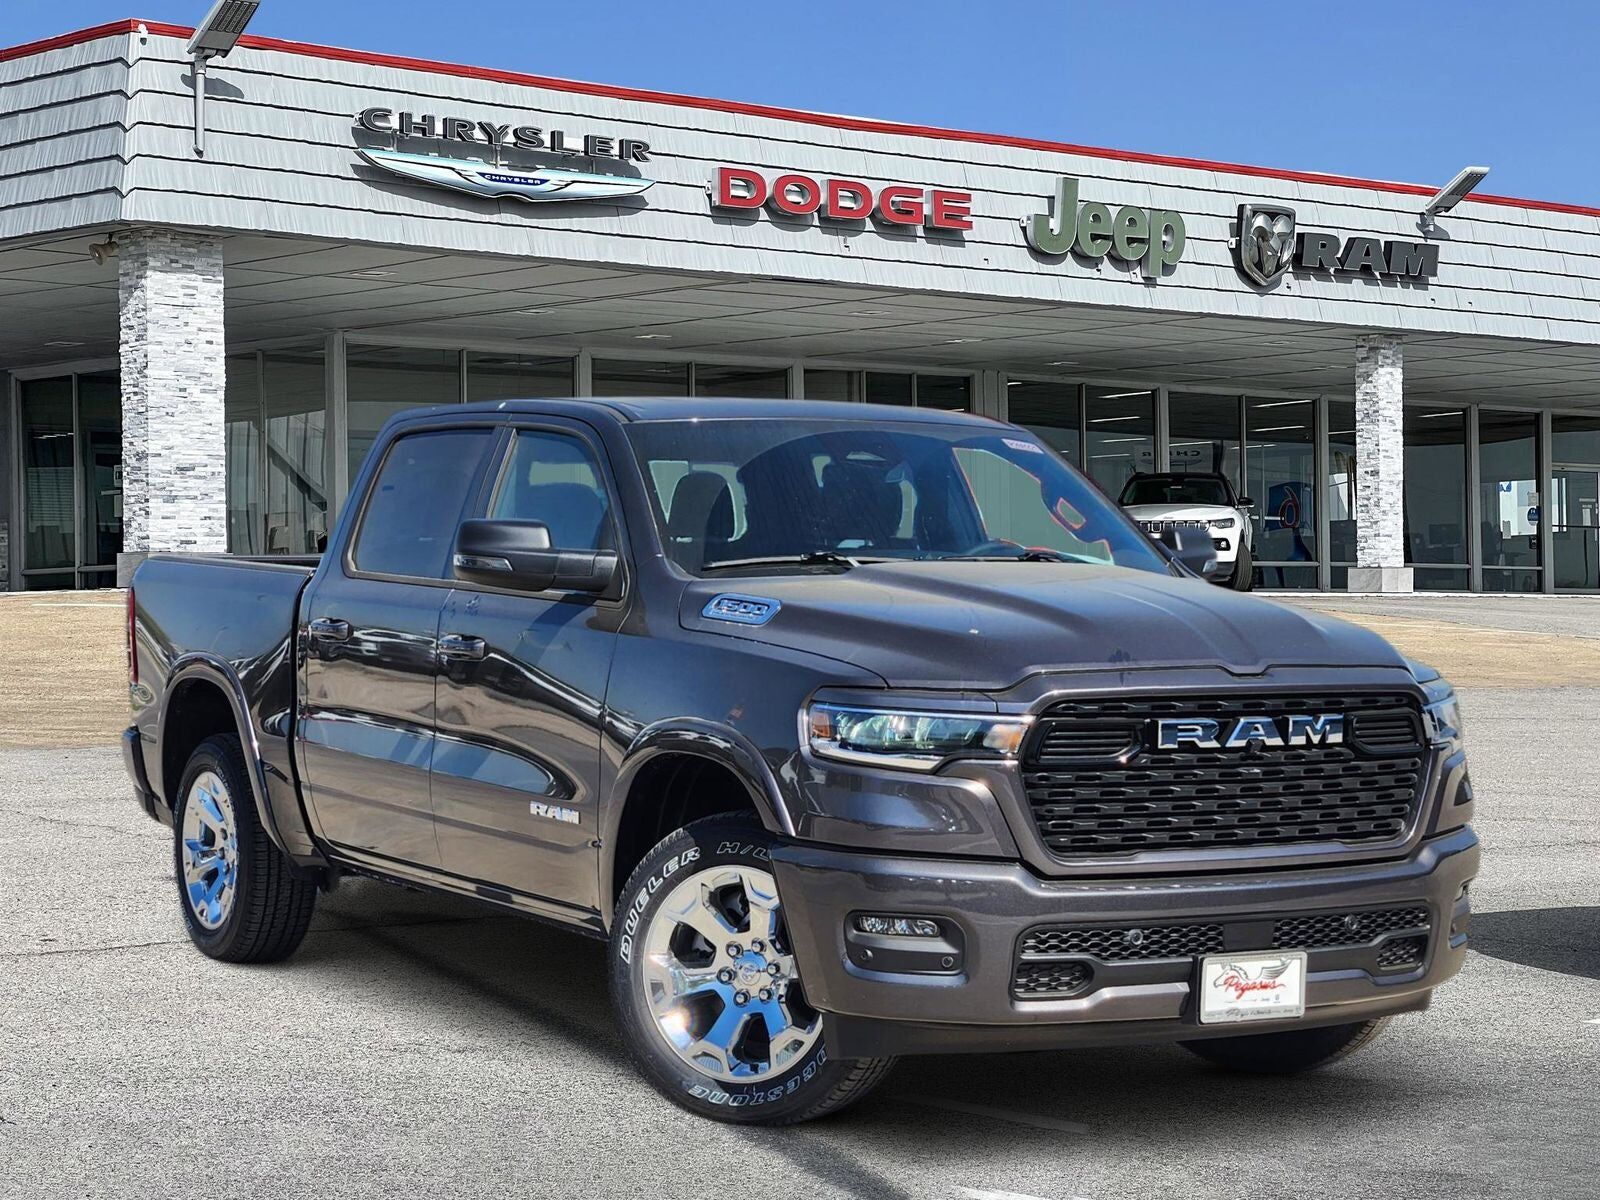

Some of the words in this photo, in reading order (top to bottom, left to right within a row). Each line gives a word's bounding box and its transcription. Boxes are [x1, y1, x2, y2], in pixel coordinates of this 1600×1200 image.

[358, 106, 652, 162] CHRYSLER
[484, 174, 542, 185] CHRYSLER
[711, 166, 974, 230] DODGE
[1025, 176, 1186, 279] Jeep
[1299, 231, 1440, 277] RAM
[1157, 713, 1344, 749] RAM
[529, 800, 581, 825] RAM
[716, 841, 771, 862] H/L
[619, 846, 700, 964] DUELER
[1223, 975, 1286, 1000] Pegasus
[687, 1043, 828, 1107] DGESTONE
